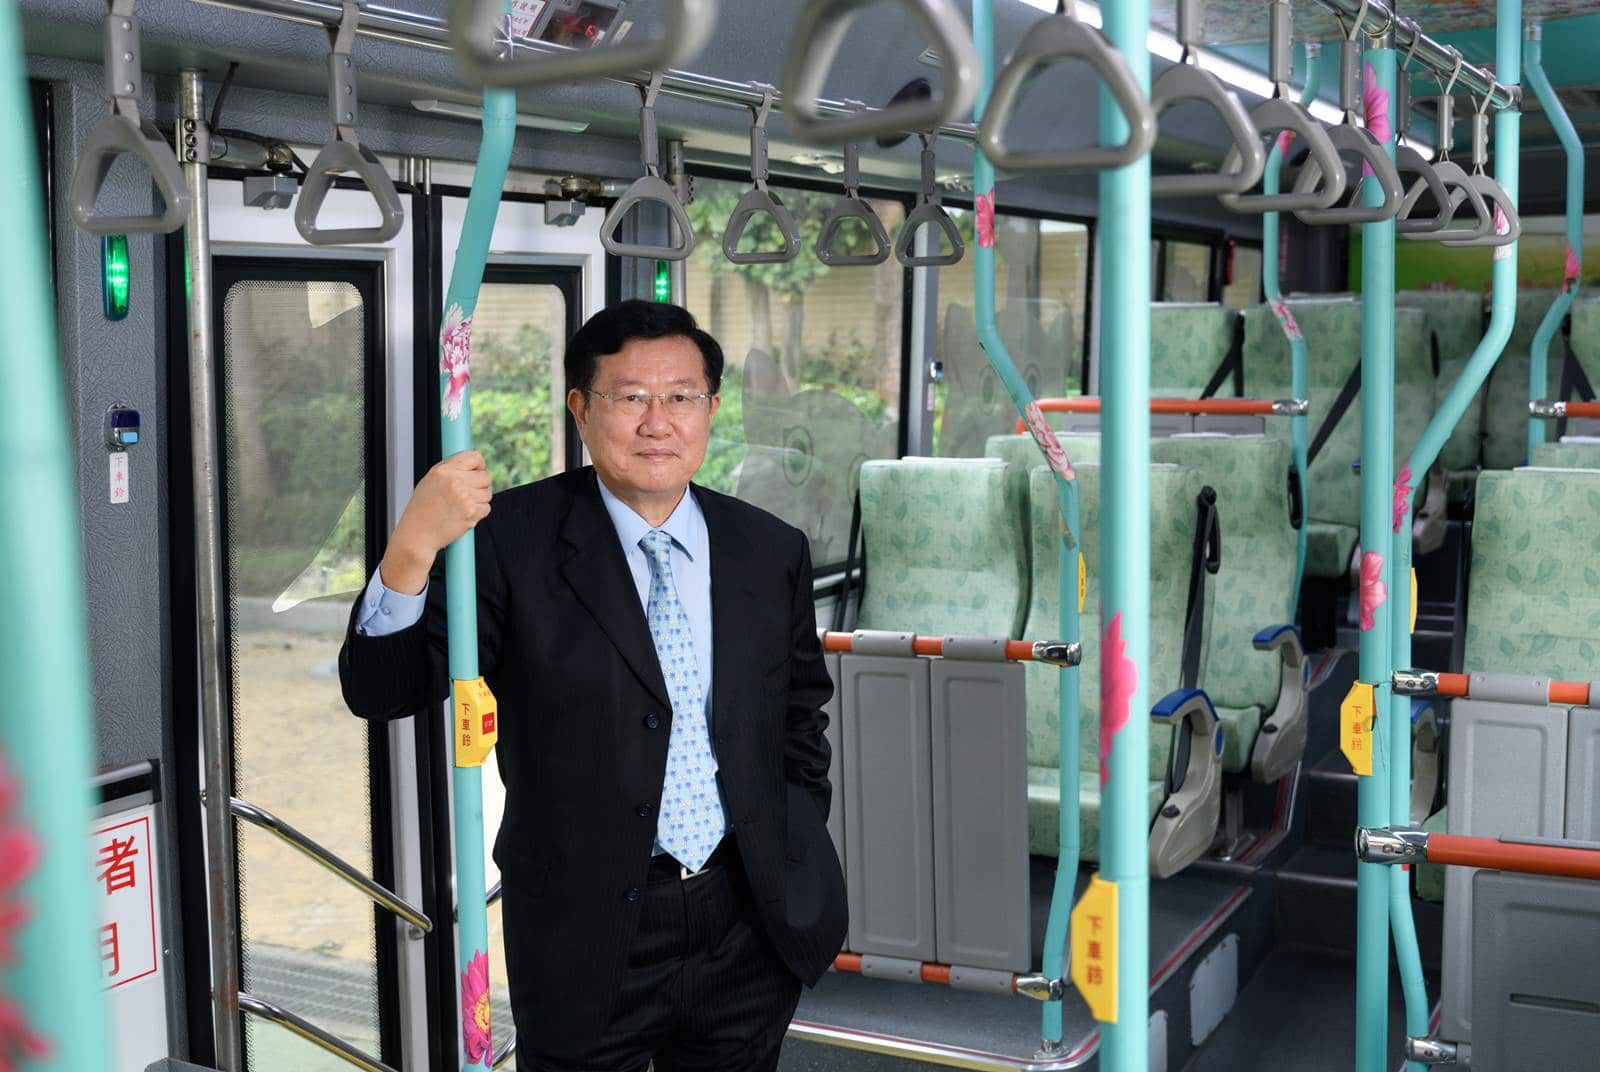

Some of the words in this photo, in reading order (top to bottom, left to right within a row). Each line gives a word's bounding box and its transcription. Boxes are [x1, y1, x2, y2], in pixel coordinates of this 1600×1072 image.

[461, 703, 471, 746] 下車鈴
[96, 835, 139, 895] 者
[1087, 915, 1103, 985] 下車鈴
